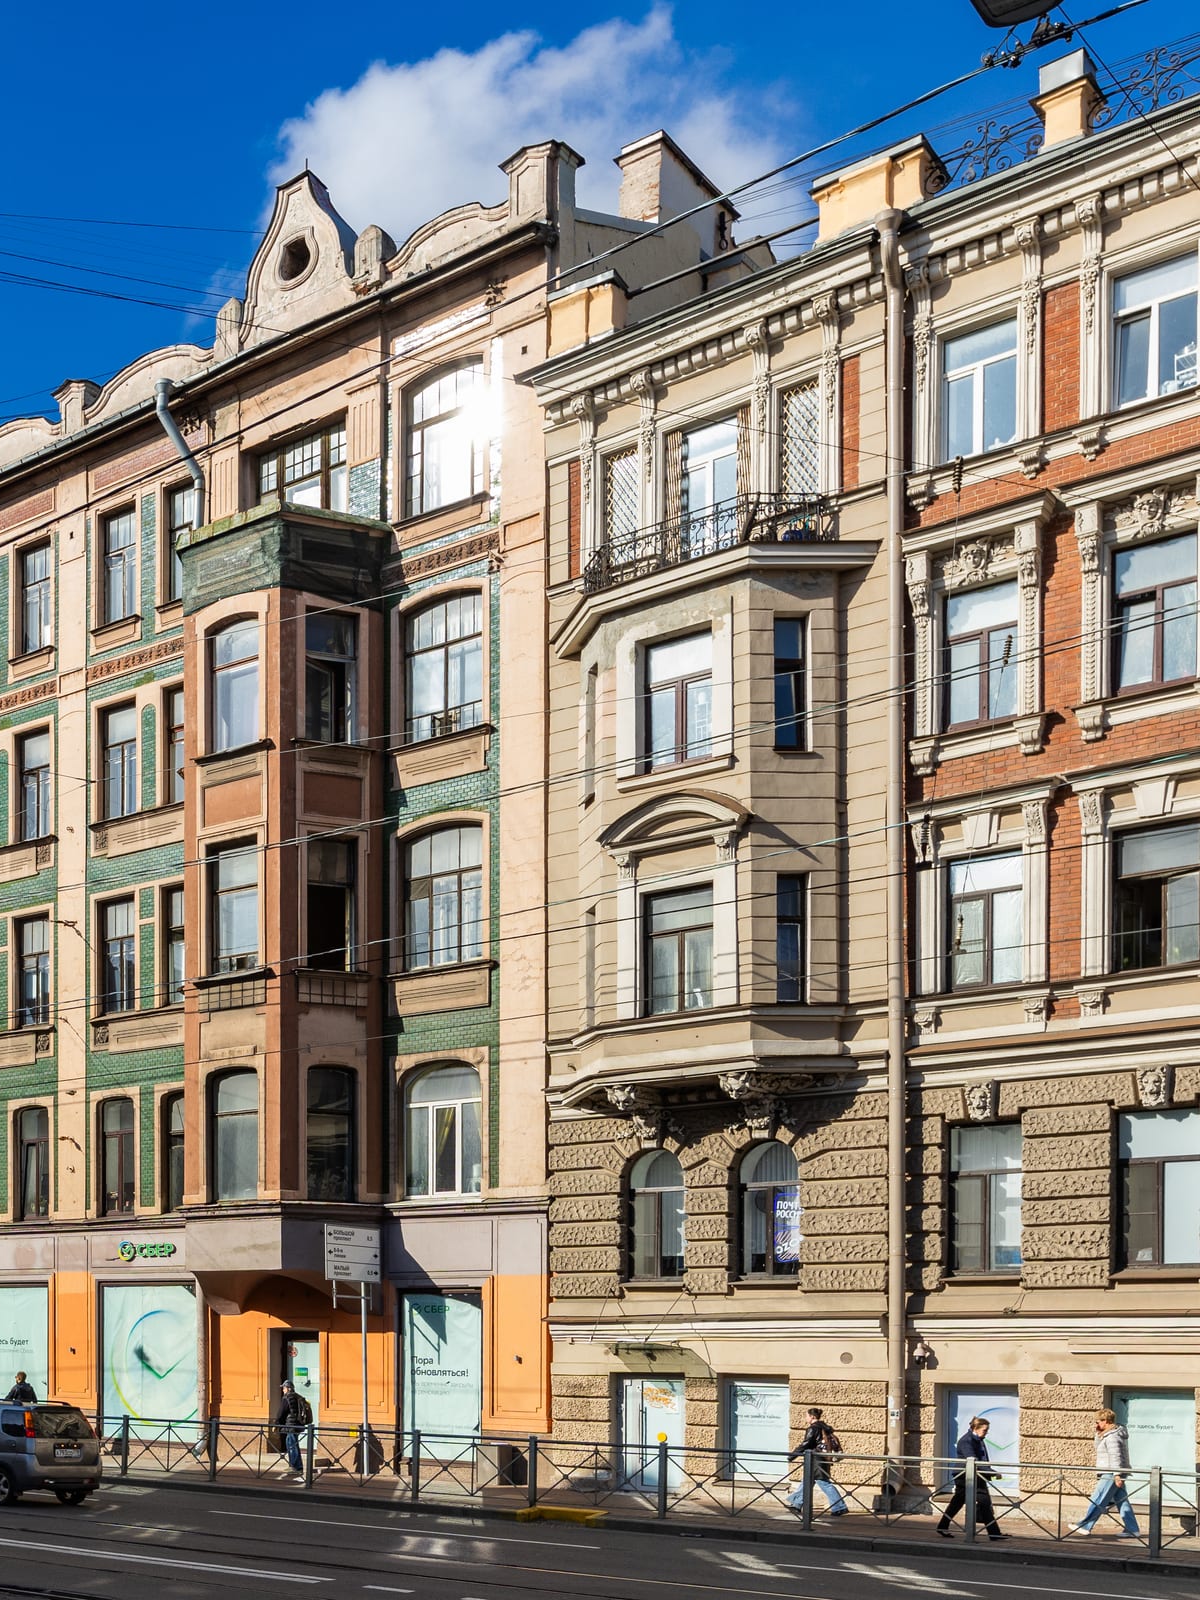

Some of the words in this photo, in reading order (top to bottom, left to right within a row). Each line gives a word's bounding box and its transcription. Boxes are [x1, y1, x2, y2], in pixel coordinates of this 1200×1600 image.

[776, 1201, 802, 1210] ПОЧТ
[136, 1243, 174, 1257] СБЕР
[423, 1305, 450, 1314] СБЕР
[9, 1337, 29, 1347] будет
[411, 1355, 434, 1366] Пора
[411, 1366, 469, 1377] обновляться!
